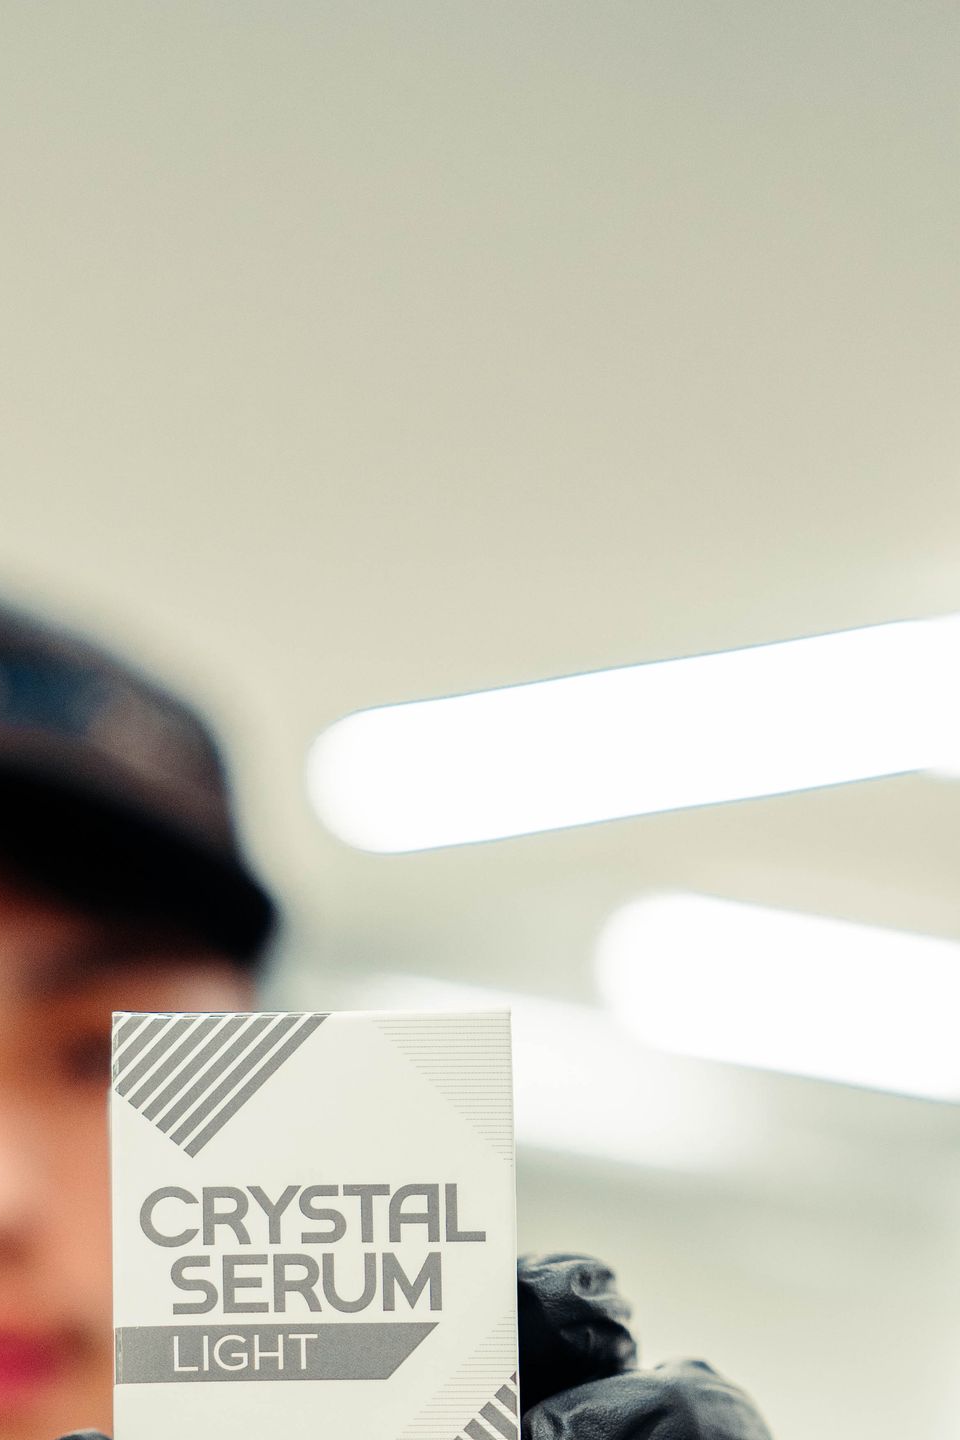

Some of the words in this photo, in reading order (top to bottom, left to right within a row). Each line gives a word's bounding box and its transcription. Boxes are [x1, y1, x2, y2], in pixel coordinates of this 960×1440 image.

[139, 1183, 487, 1248] CRYSTAL
[170, 1251, 443, 1315] SERUM
[172, 1333, 319, 1372] LIGHT
